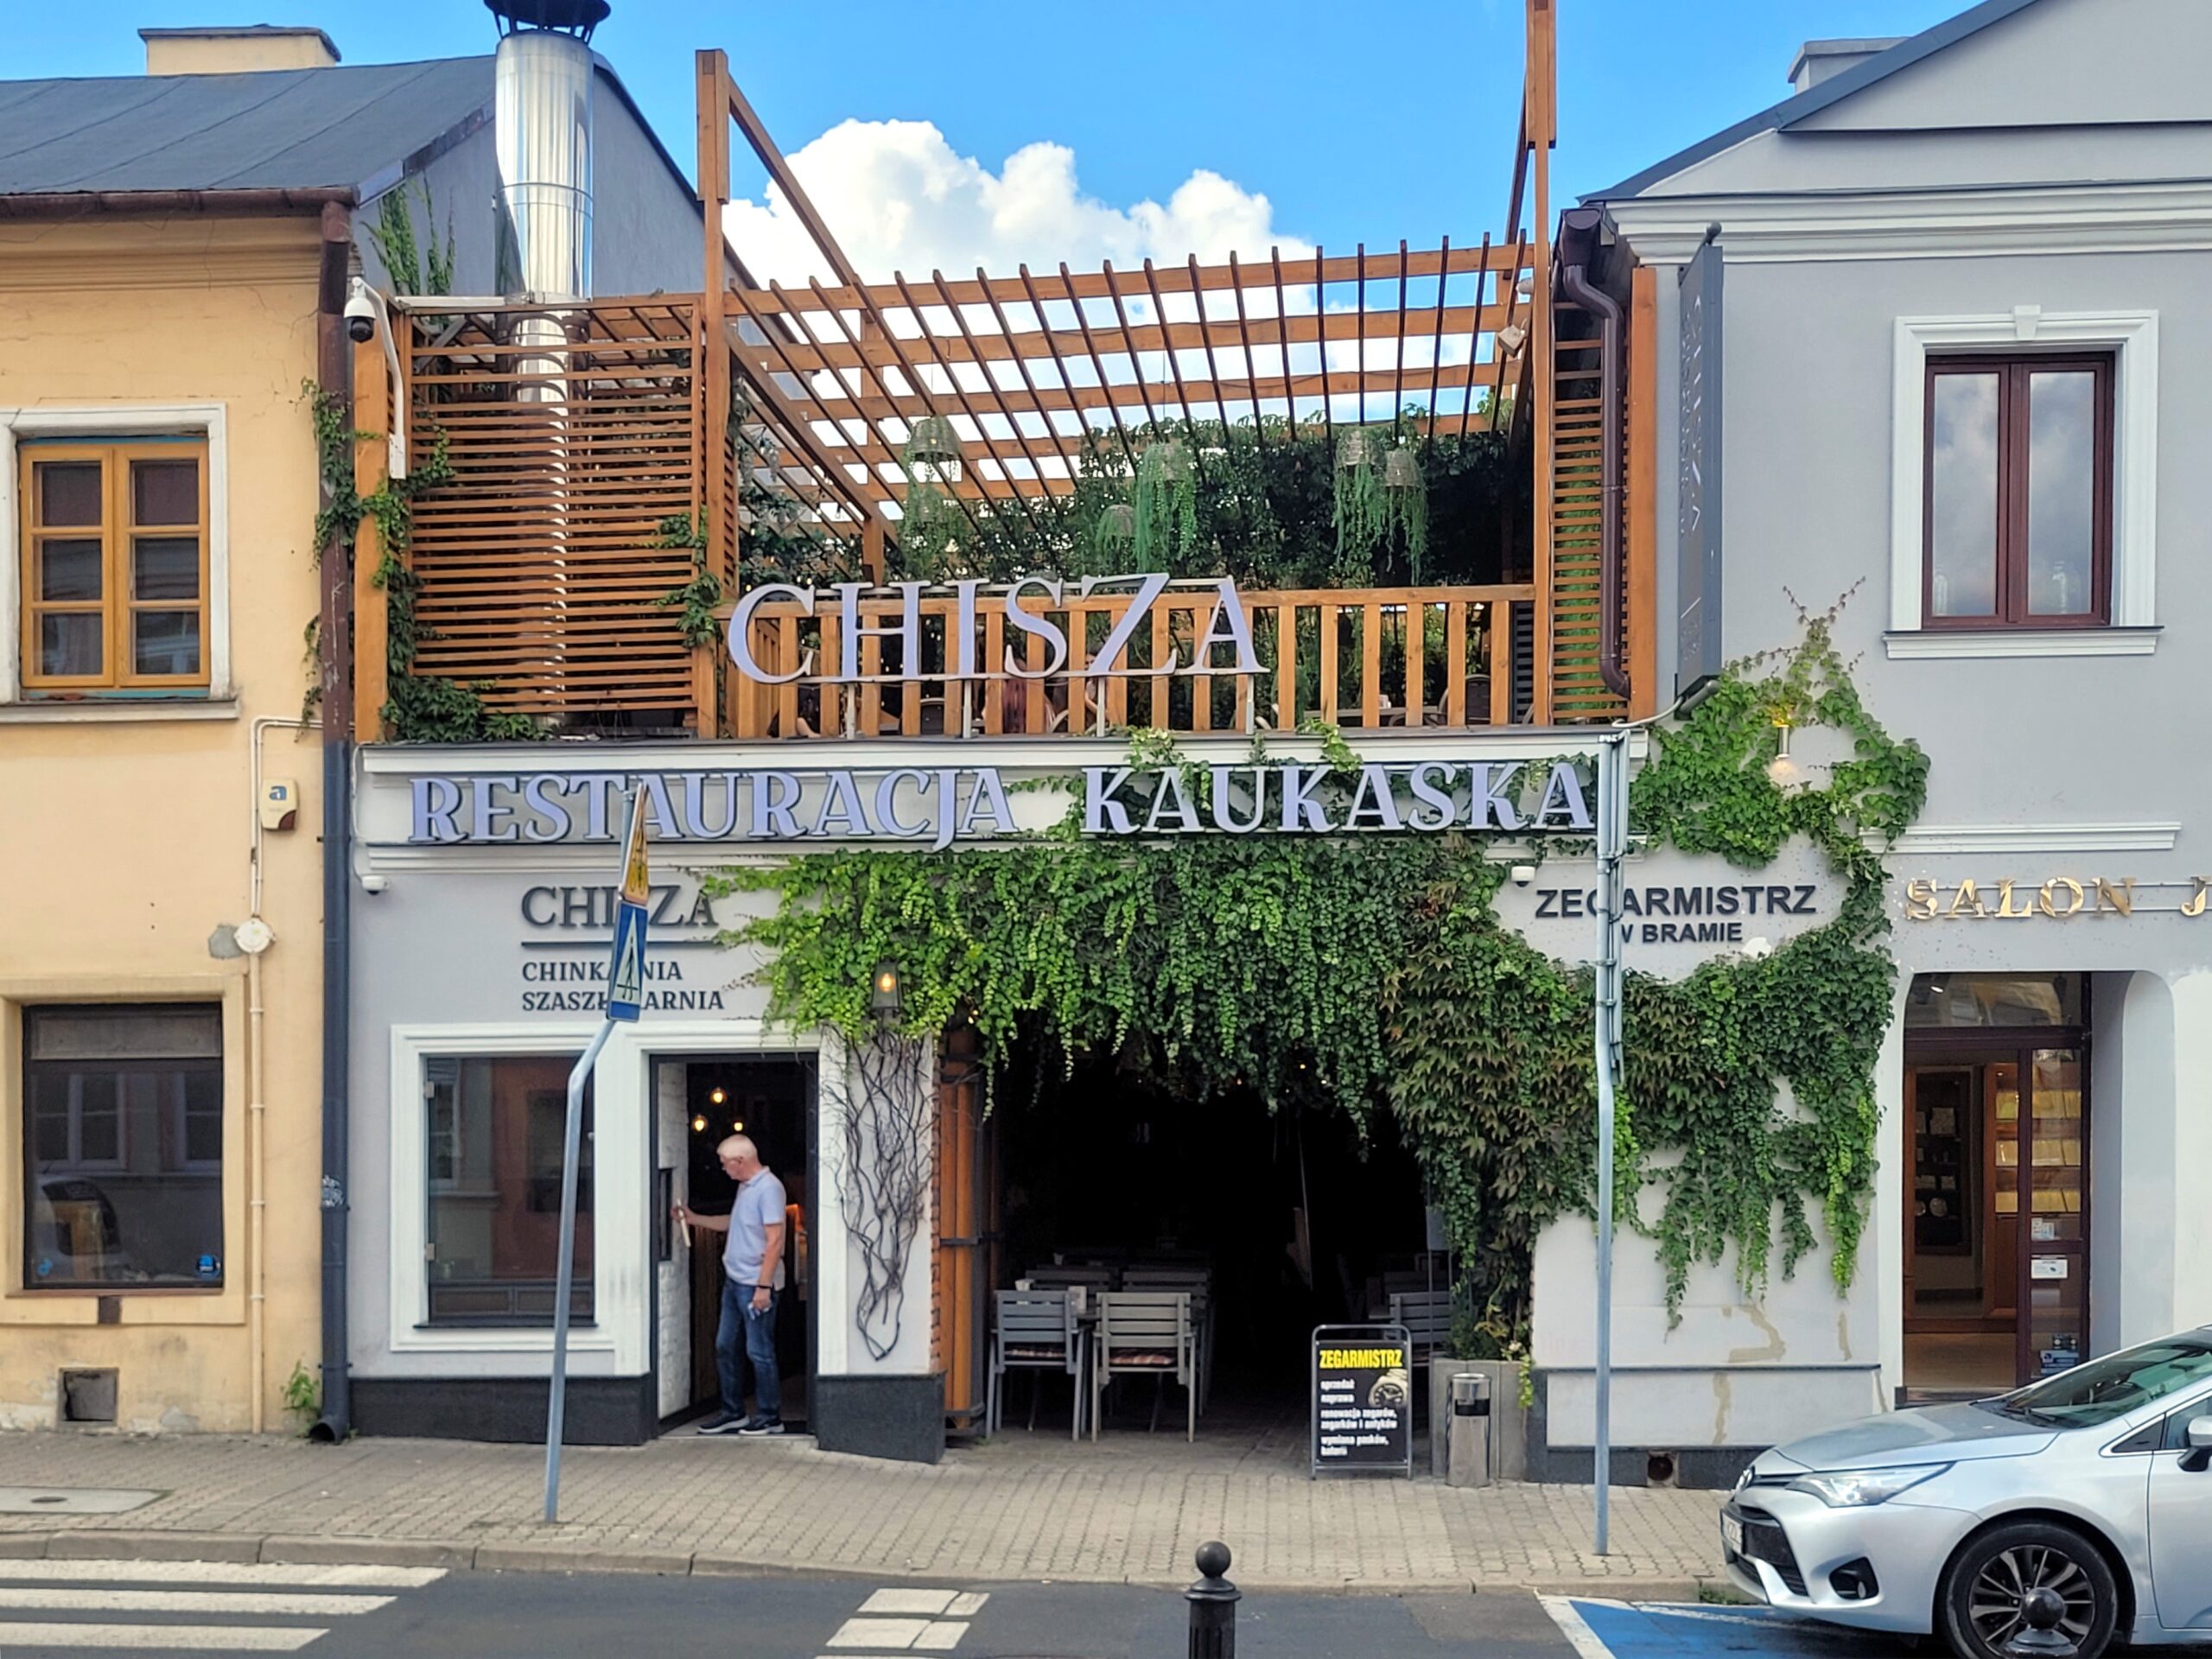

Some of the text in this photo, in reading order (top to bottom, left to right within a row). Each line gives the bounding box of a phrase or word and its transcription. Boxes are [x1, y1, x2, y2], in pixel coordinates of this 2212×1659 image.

[728, 574, 1270, 684] CHISZA
[408, 761, 1596, 853] RESTAURACJA KAUKASKA
[520, 885, 720, 928] CHIZA
[1905, 875, 2138, 920] SALON
[1642, 922, 1744, 944] BRAMIE
[522, 960, 683, 982] CHINKNIA
[522, 989, 725, 1011] SZASZŁARNIA
[1319, 1349, 1402, 1368] ZEGARMISTRZ
